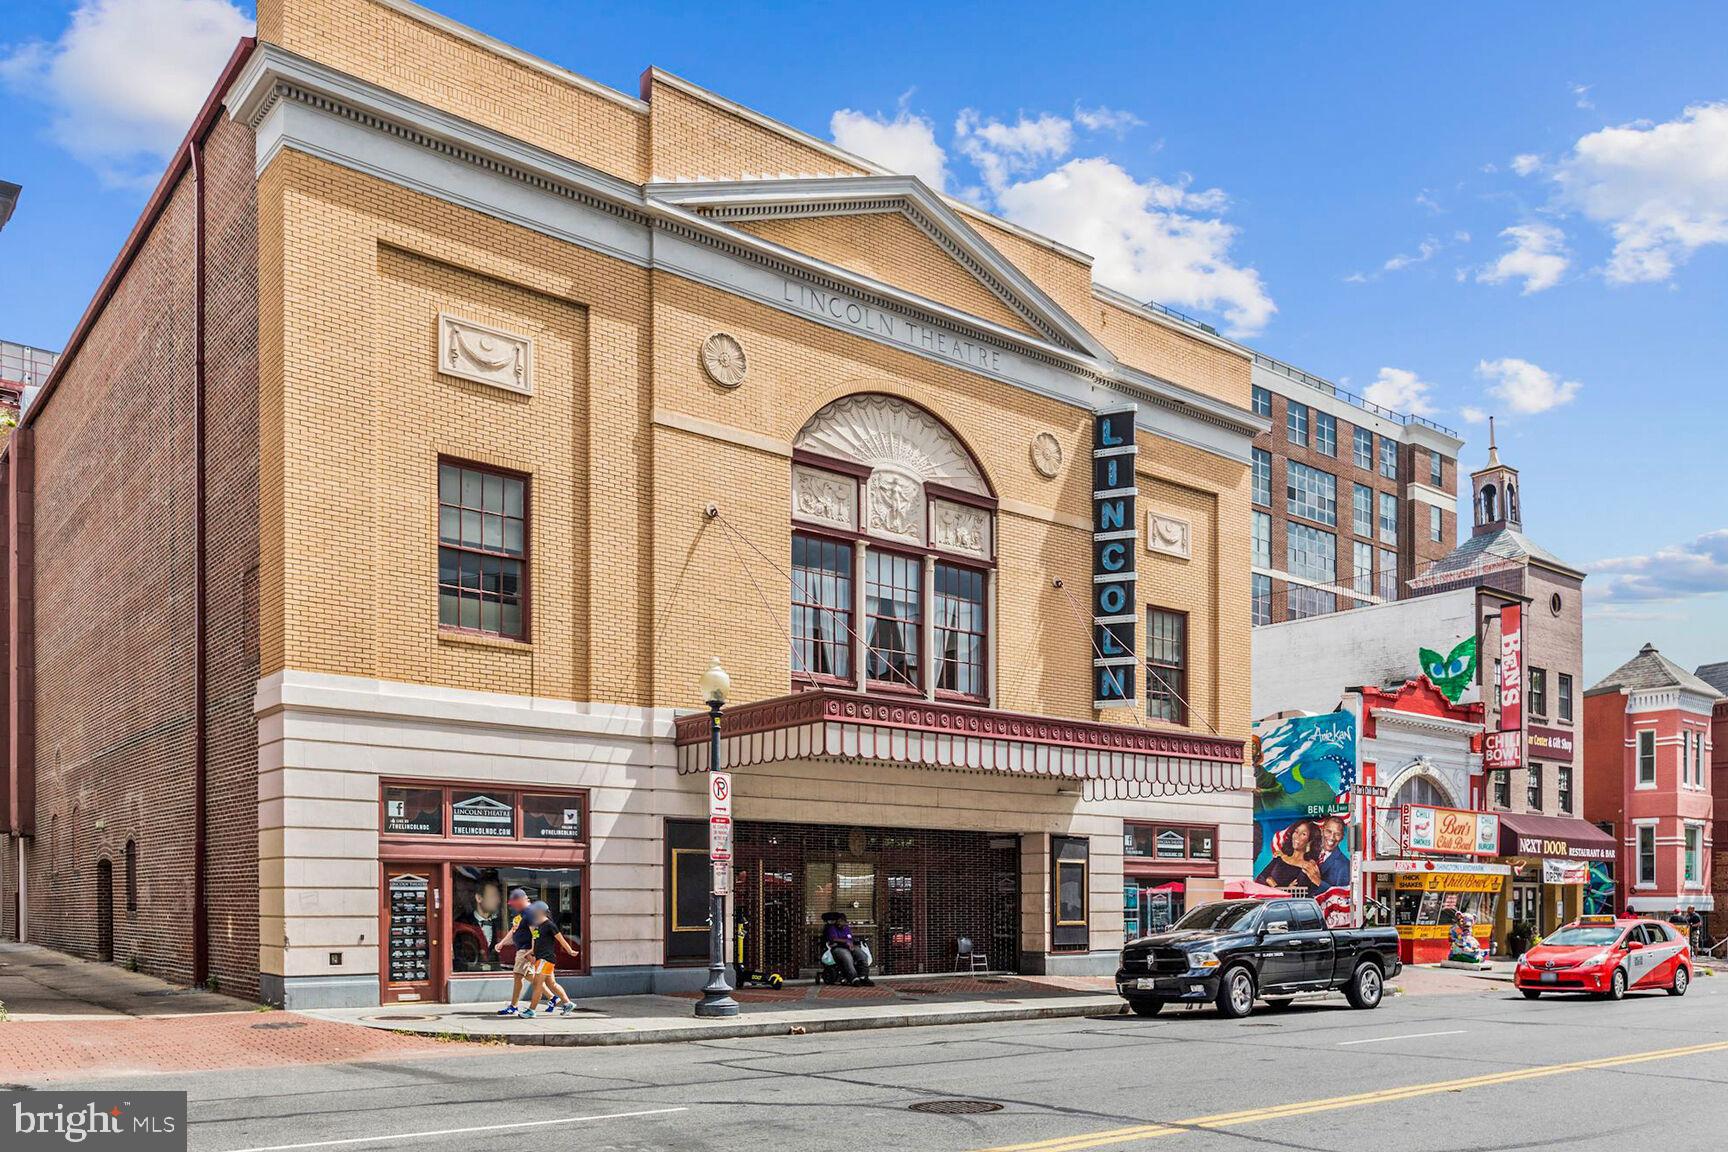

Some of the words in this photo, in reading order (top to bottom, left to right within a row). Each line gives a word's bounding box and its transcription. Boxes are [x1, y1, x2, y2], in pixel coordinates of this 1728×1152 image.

[784, 281, 894, 336] LINCOLN
[905, 322, 1000, 371] THEATRE
[1101, 418, 1124, 697] LINCOLN
[1486, 731, 1520, 749] CHILI
[1486, 748, 1520, 761] BOWL
[1308, 805, 1324, 814] BEN
[1327, 804, 1339, 813] ALI
[1440, 813, 1471, 836] Ben's
[1436, 835, 1453, 849] Chili
[1453, 836, 1473, 850] Bowl
[1544, 840, 1567, 855] DOOR
[1568, 847, 1600, 857] RESTAURANT
[1600, 849, 1605, 857] &
[1605, 849, 1616, 858] BAR
[1442, 873, 1464, 888] Chili
[1465, 874, 1489, 888] Bowl
